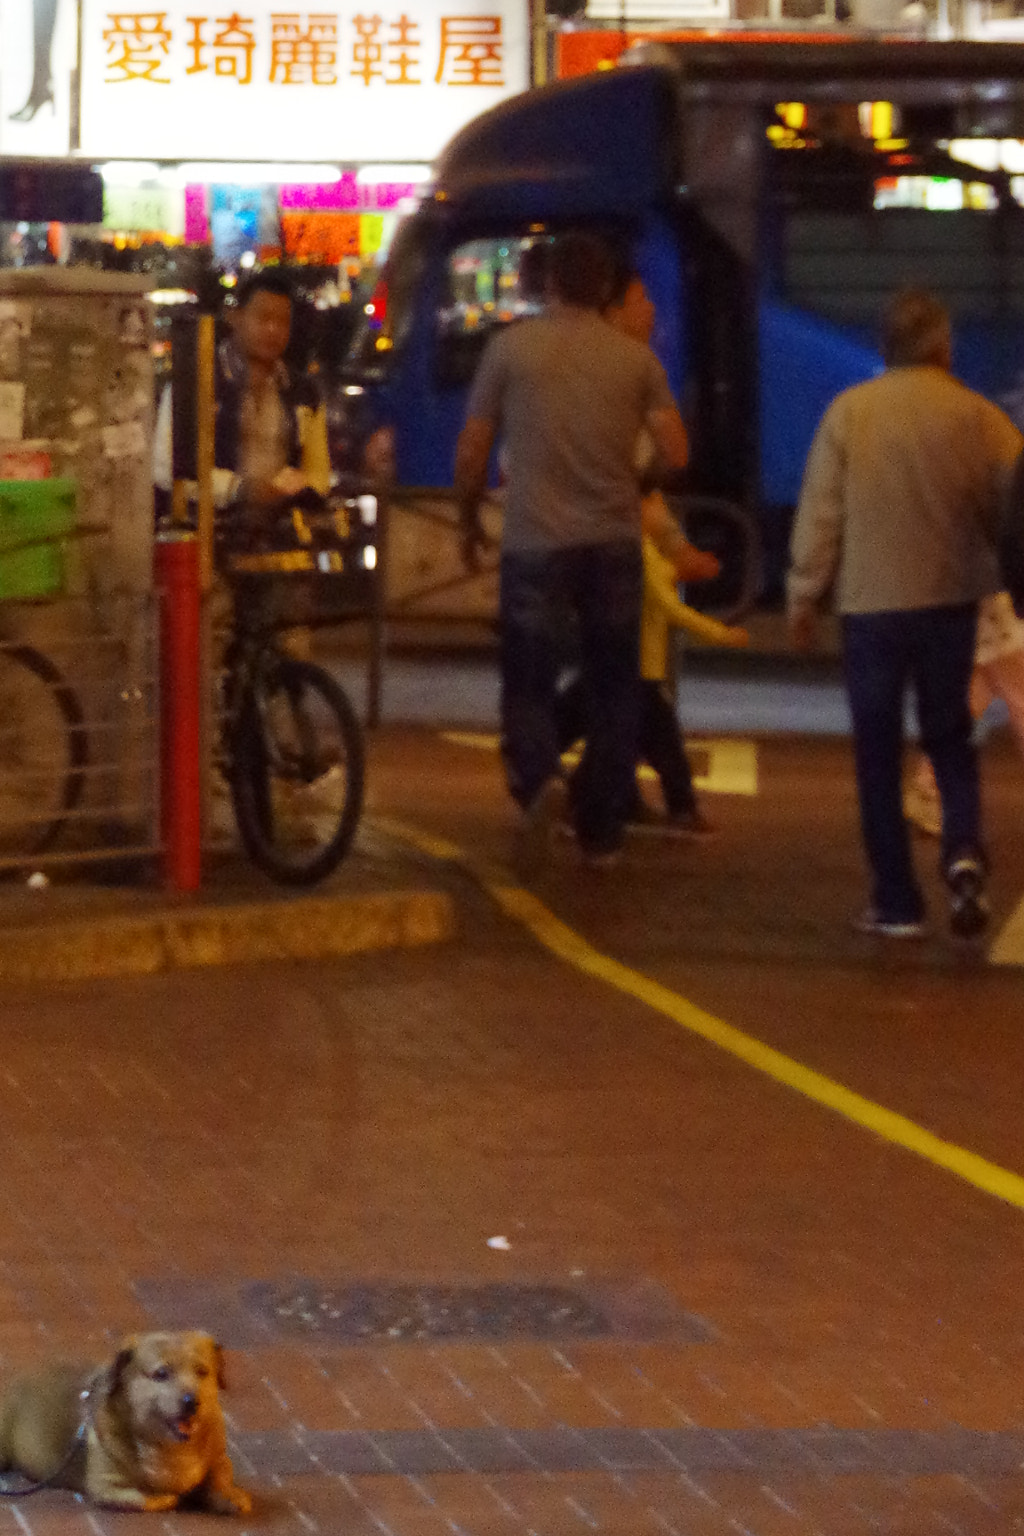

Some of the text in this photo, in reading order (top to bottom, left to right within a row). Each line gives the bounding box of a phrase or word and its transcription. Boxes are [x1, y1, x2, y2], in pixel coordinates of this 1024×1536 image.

[102, 11, 506, 87] 愛琦麗鞋屋
